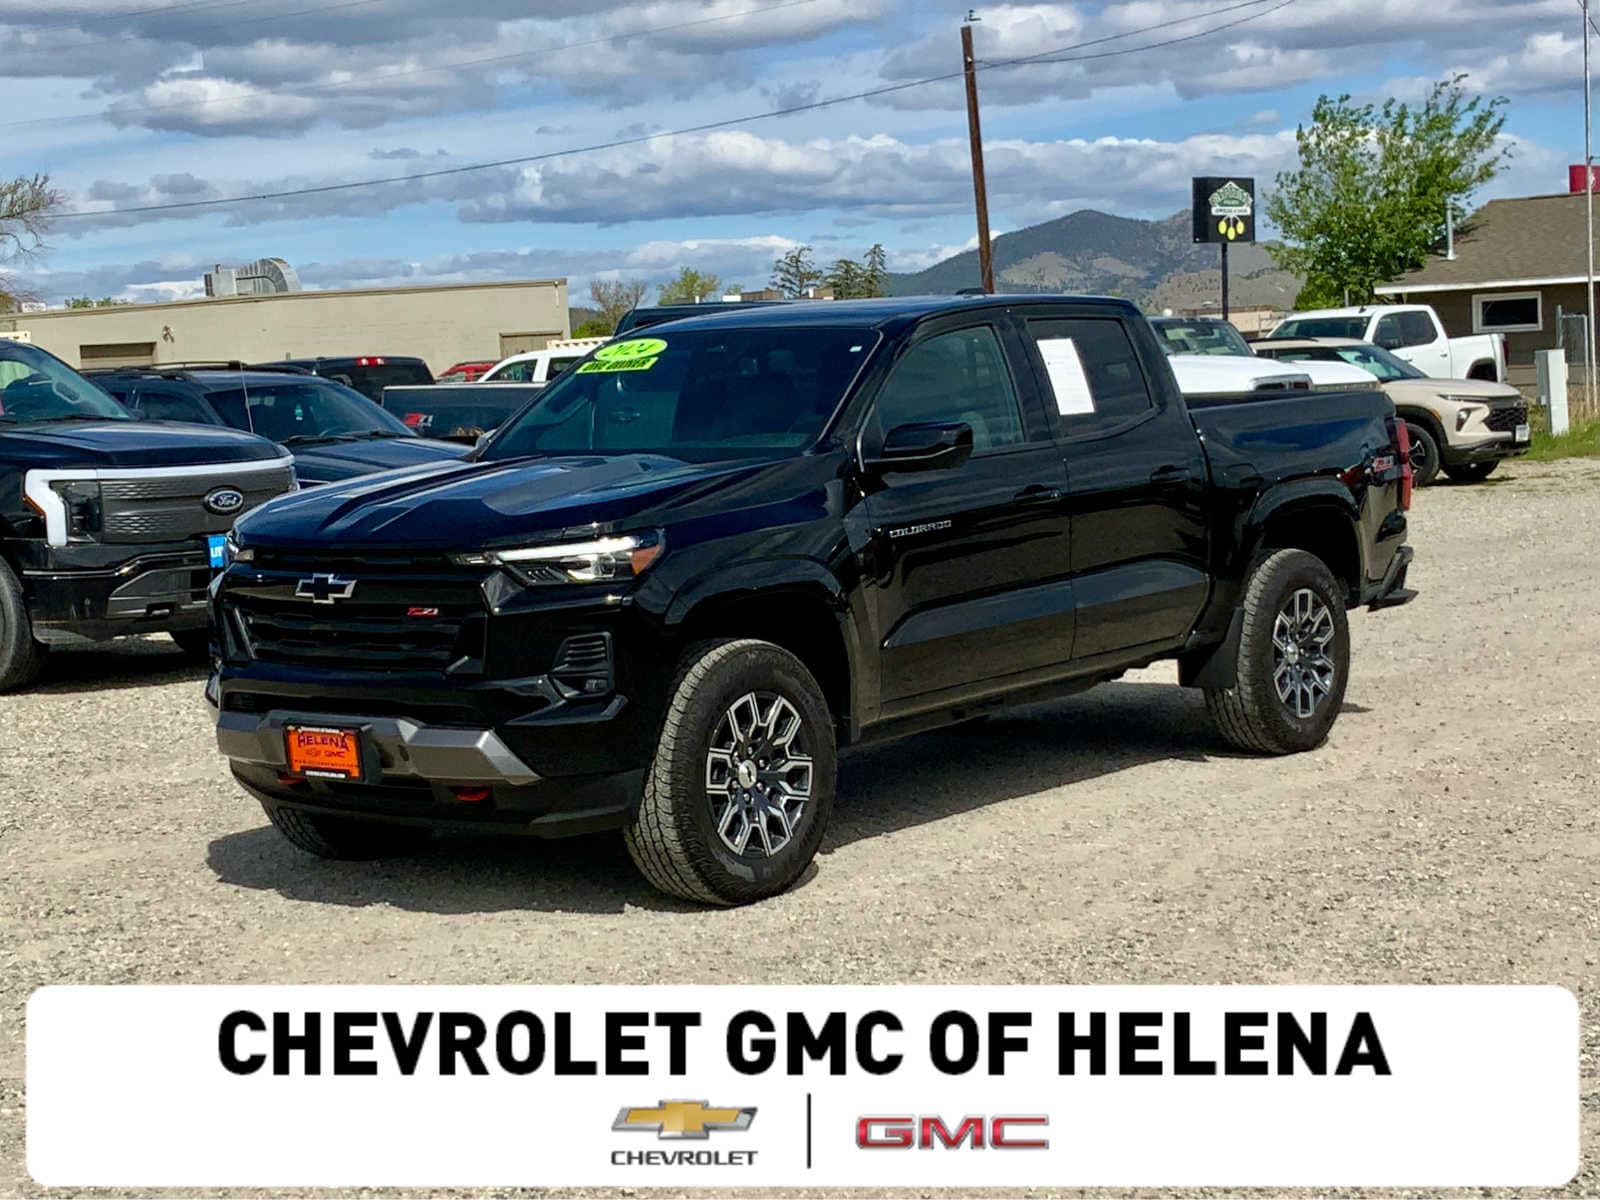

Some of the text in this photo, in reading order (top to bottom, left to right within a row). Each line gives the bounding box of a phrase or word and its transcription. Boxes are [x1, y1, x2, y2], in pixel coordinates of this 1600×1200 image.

[889, 519, 953, 539] COLORADO
[297, 734, 350, 752] HELENA
[324, 750, 345, 758] GMC
